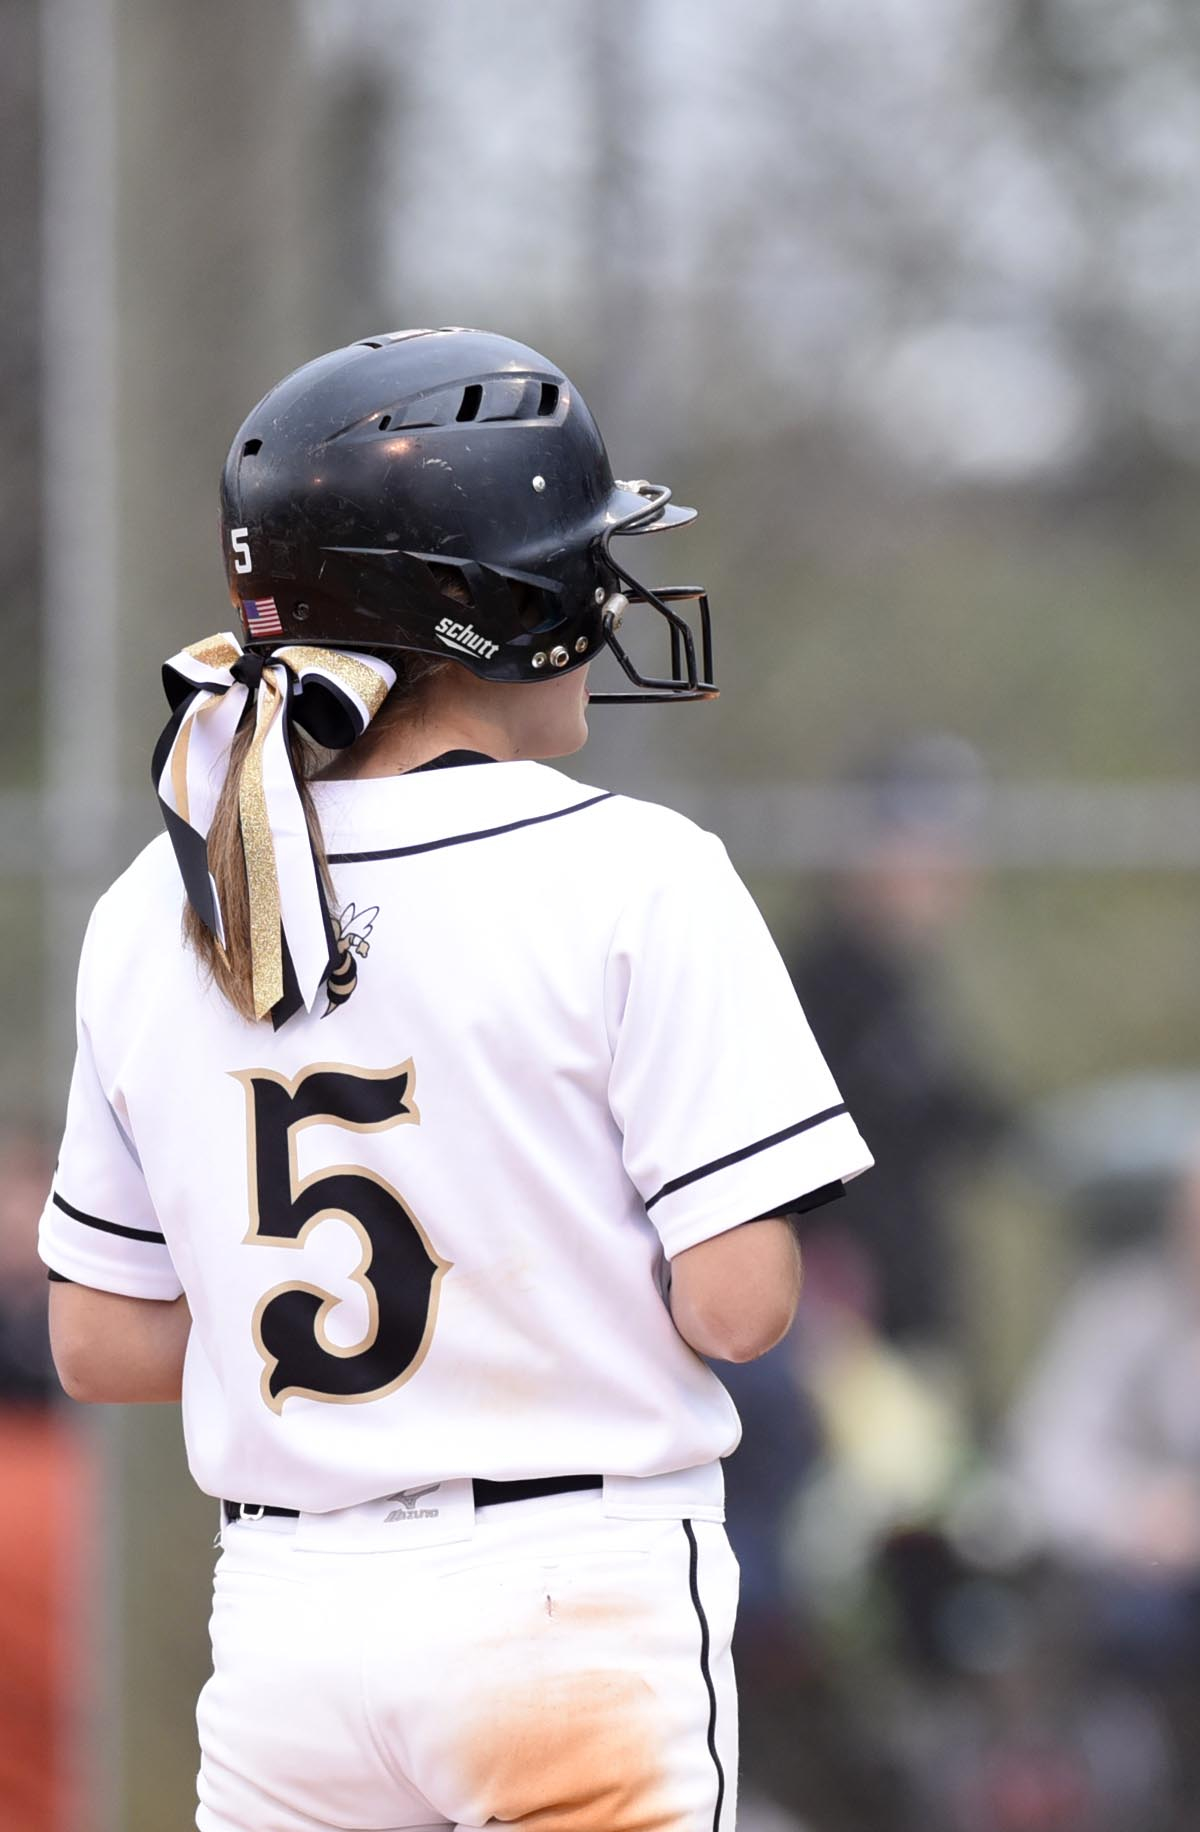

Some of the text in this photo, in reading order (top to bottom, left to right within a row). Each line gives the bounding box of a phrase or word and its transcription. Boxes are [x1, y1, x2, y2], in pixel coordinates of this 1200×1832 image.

[231, 527, 252, 574] 5
[434, 617, 499, 659] schutt
[225, 1056, 455, 1417] 5
